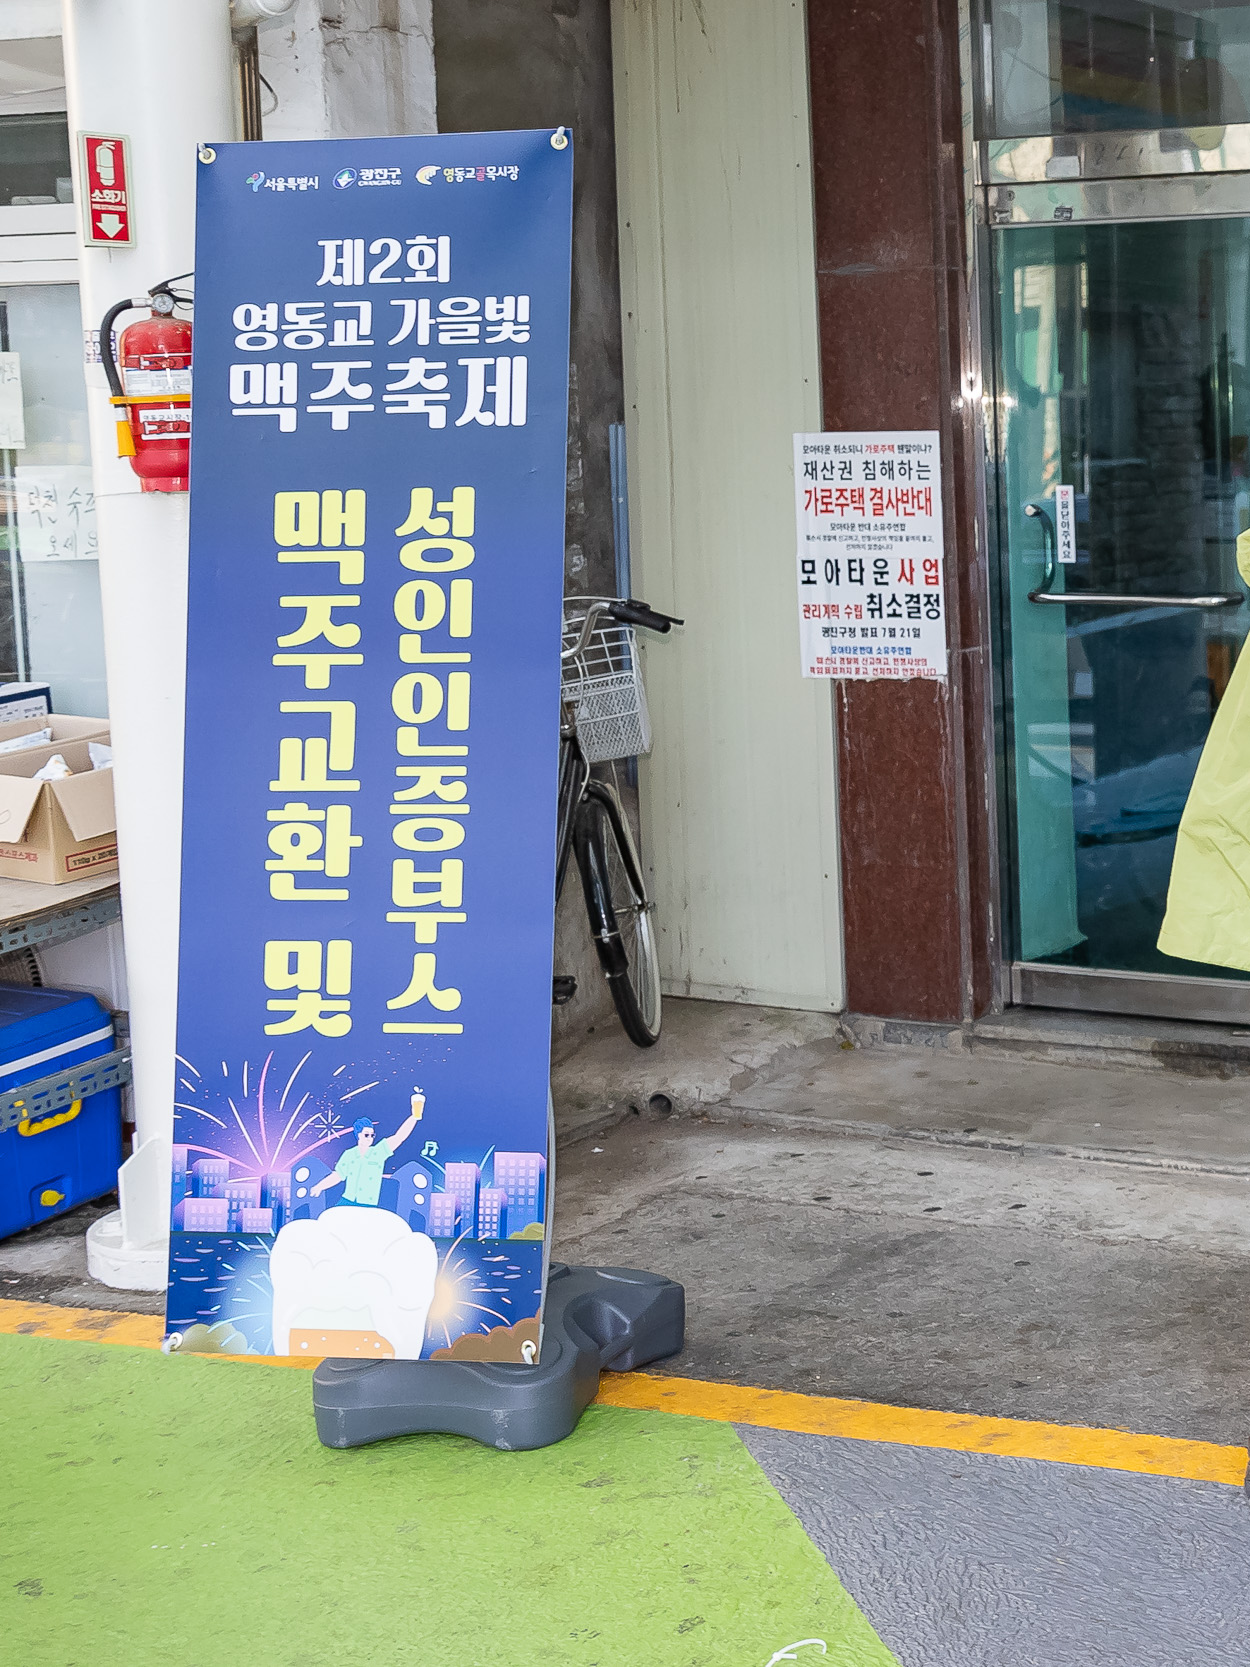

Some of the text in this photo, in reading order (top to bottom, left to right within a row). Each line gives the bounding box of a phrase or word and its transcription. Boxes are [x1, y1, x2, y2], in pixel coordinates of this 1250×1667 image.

[264, 176, 319, 191] 서울특별시
[359, 168, 402, 181] 광진구
[443, 166, 520, 183] 영동교골목시장
[91, 189, 126, 204] 소화기
[316, 235, 450, 287] 제2회
[232, 295, 530, 351] 영동교 가을빛
[229, 356, 528, 432] 맥주축제
[803, 459, 931, 481] 재산권 침해하는
[804, 486, 932, 517] 가로주택 결사반대
[801, 558, 940, 586] 모아타운 사업
[844, 604, 863, 620] 수립
[866, 593, 940, 620] 취소결정
[860, 626, 878, 639] 발표
[899, 626, 921, 639] 21일
[264, 489, 367, 1038] 맥주교환 및
